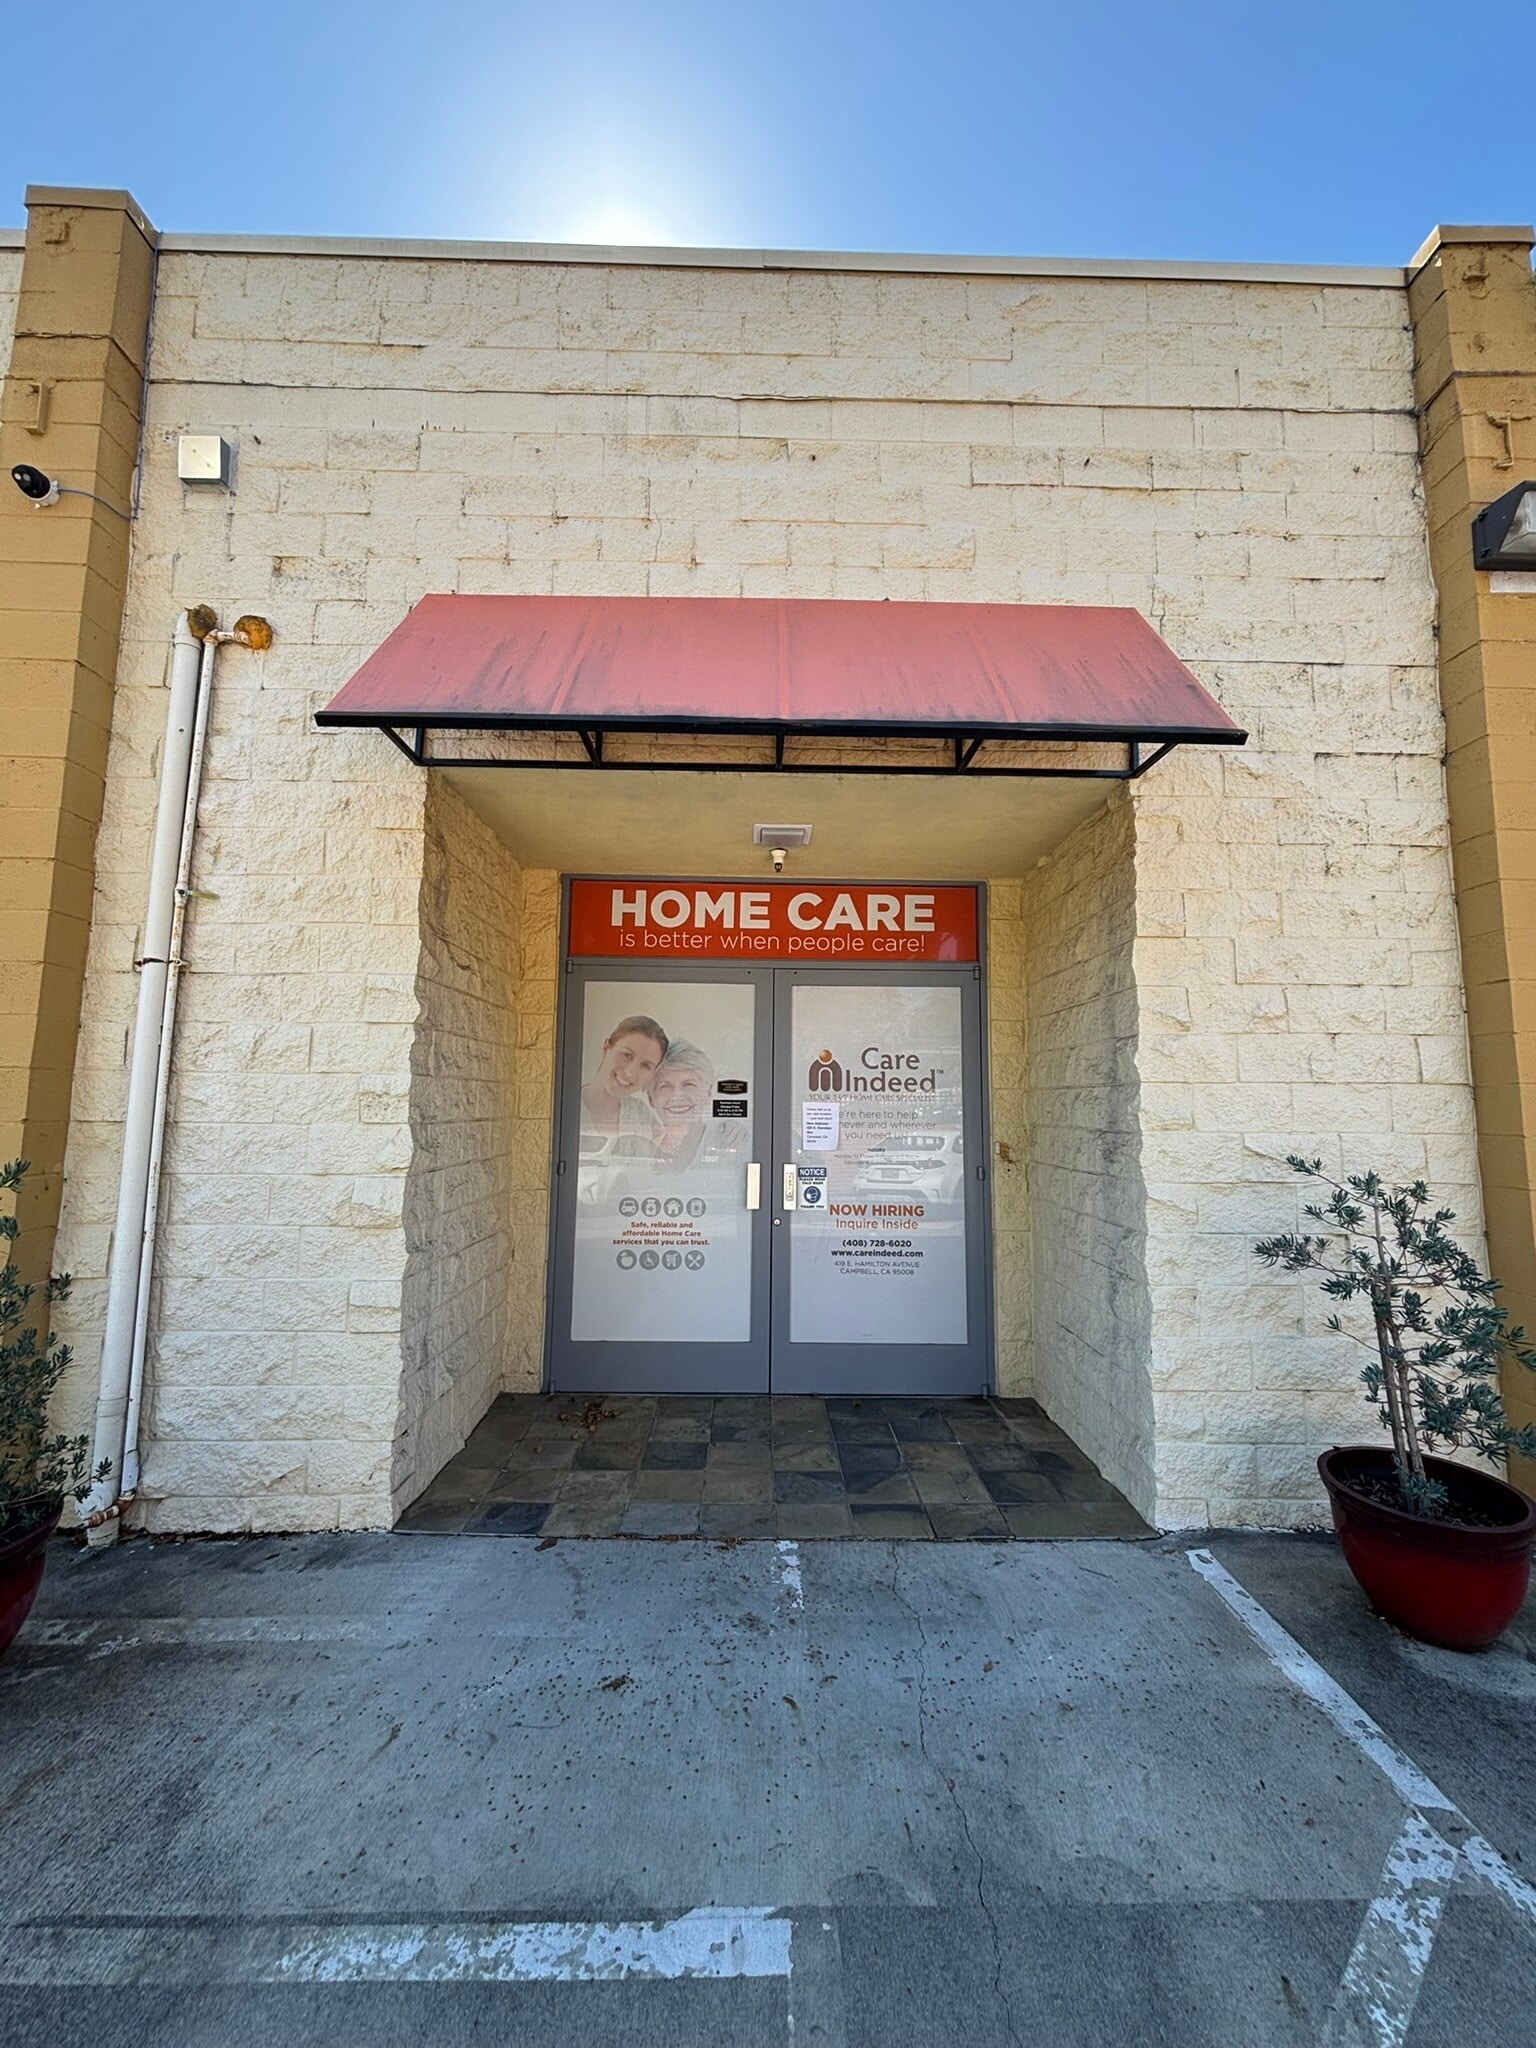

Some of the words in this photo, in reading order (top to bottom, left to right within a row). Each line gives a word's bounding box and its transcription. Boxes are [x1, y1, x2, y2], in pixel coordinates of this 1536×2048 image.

[611, 889, 771, 929] HOME
[787, 892, 935, 932] CARE
[619, 929, 636, 948] is
[644, 930, 712, 949] better
[720, 931, 780, 951] when
[788, 932, 864, 954] people
[872, 934, 925, 952] care!
[861, 1047, 920, 1070] Care
[845, 1069, 936, 1093] Indeed
[809, 1093, 831, 1101] YOUR
[850, 1093, 873, 1101] HOME
[839, 1110, 857, 1119] e're
[860, 1110, 882, 1119] here
[883, 1110, 894, 1119] to
[897, 1110, 919, 1121] help
[868, 1120, 887, 1129] and
[891, 1121, 936, 1130] wherever
[845, 1131, 863, 1140] you
[866, 1130, 891, 1139] need
[799, 1168, 825, 1176] NOTICE
[829, 1204, 868, 1216] NOW
[872, 1205, 925, 1217] HIRING
[836, 1218, 878, 1230] Inquire
[882, 1219, 918, 1230] Inside
[842, 1239, 868, 1248] (408)
[870, 1239, 912, 1247] 728-6020
[831, 1249, 924, 1258] www.careindeed.com
